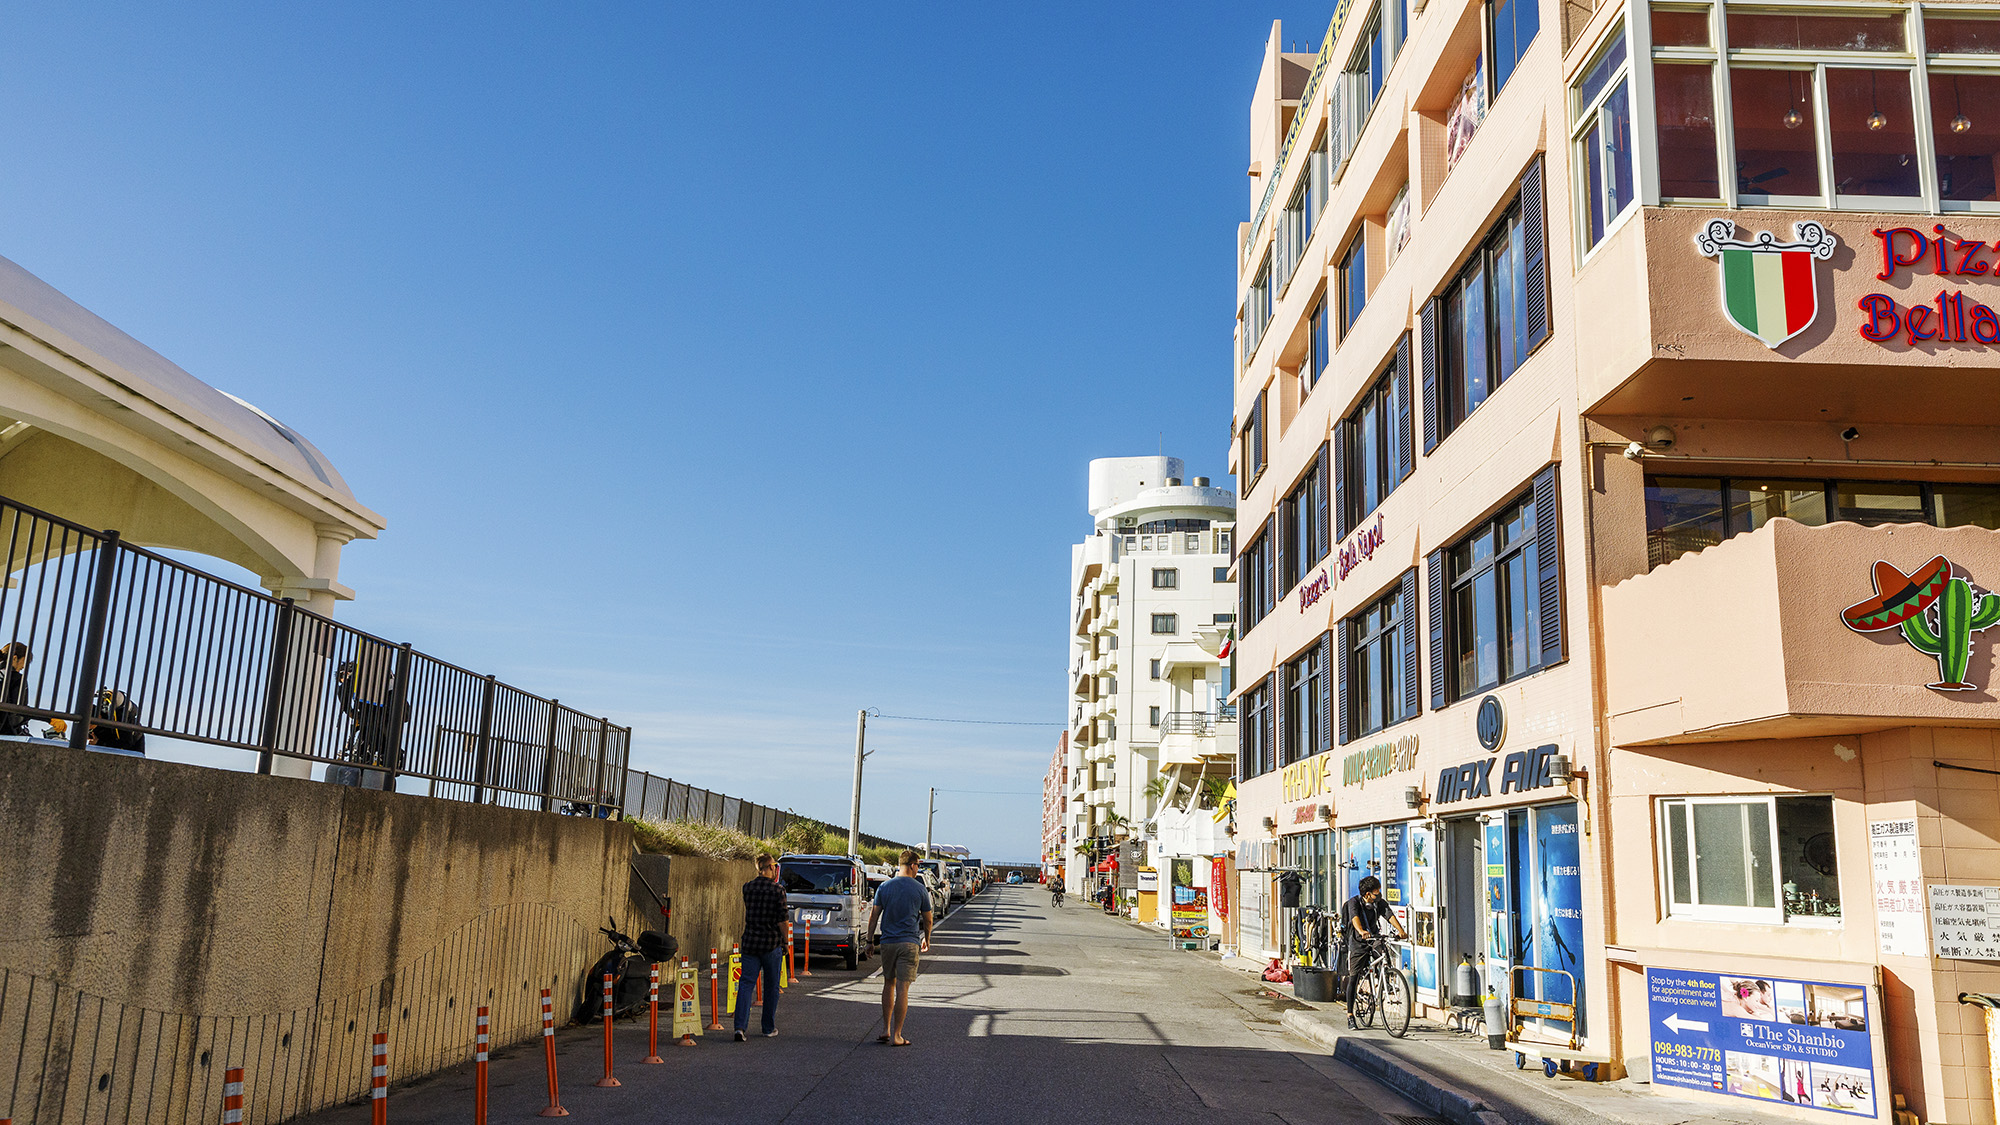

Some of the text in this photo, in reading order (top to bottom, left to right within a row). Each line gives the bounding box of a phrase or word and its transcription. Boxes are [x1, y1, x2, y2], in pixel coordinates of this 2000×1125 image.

[1872, 223, 2000, 280] Piz
[1858, 290, 2000, 345] Bella
[1365, 742, 1392, 780] SCHOOL
[1397, 734, 1420, 772] SHOP
[1436, 744, 1560, 804] MAX AIR
[1876, 880, 1920, 895] 火気厳禁
[1940, 946, 2000, 957] 無断立入禁
[1651, 976, 1715, 989] Stop by the 4th floor
[1651, 984, 1716, 998] for appointment and
[1652, 995, 1717, 1007] amazing ocean view!
[1754, 1024, 1845, 1049] The Shanbio
[1654, 1041, 1721, 1062] 098-983-7778
[1782, 1044, 1797, 1053] SPA
[1805, 1047, 1838, 1058] STUDIO
[1656, 1073, 1712, 1087] okinawa@shanbio.com
